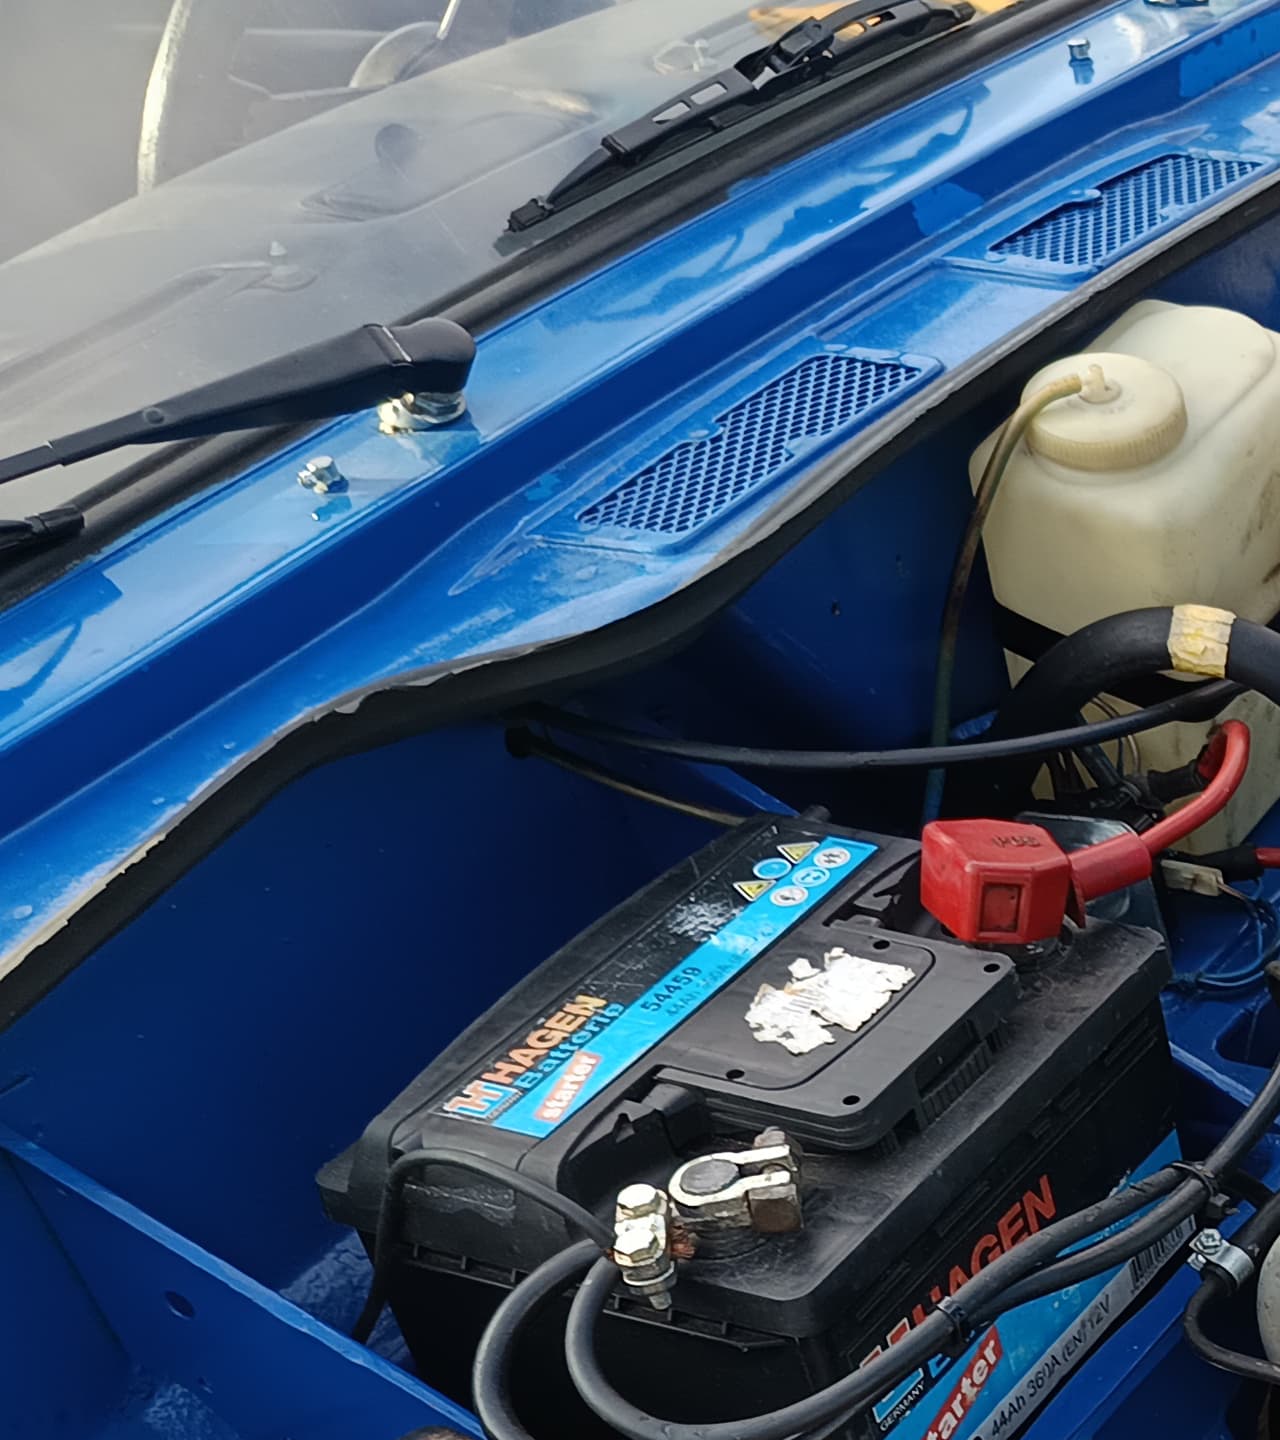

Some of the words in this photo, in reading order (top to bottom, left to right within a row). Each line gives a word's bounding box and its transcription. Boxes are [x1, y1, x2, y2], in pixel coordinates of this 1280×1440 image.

[640, 966, 703, 1014] 54459
[484, 994, 608, 1085] HAGEN
[541, 1054, 599, 1121] starter
[991, 1394, 1028, 1438] 44Ah
